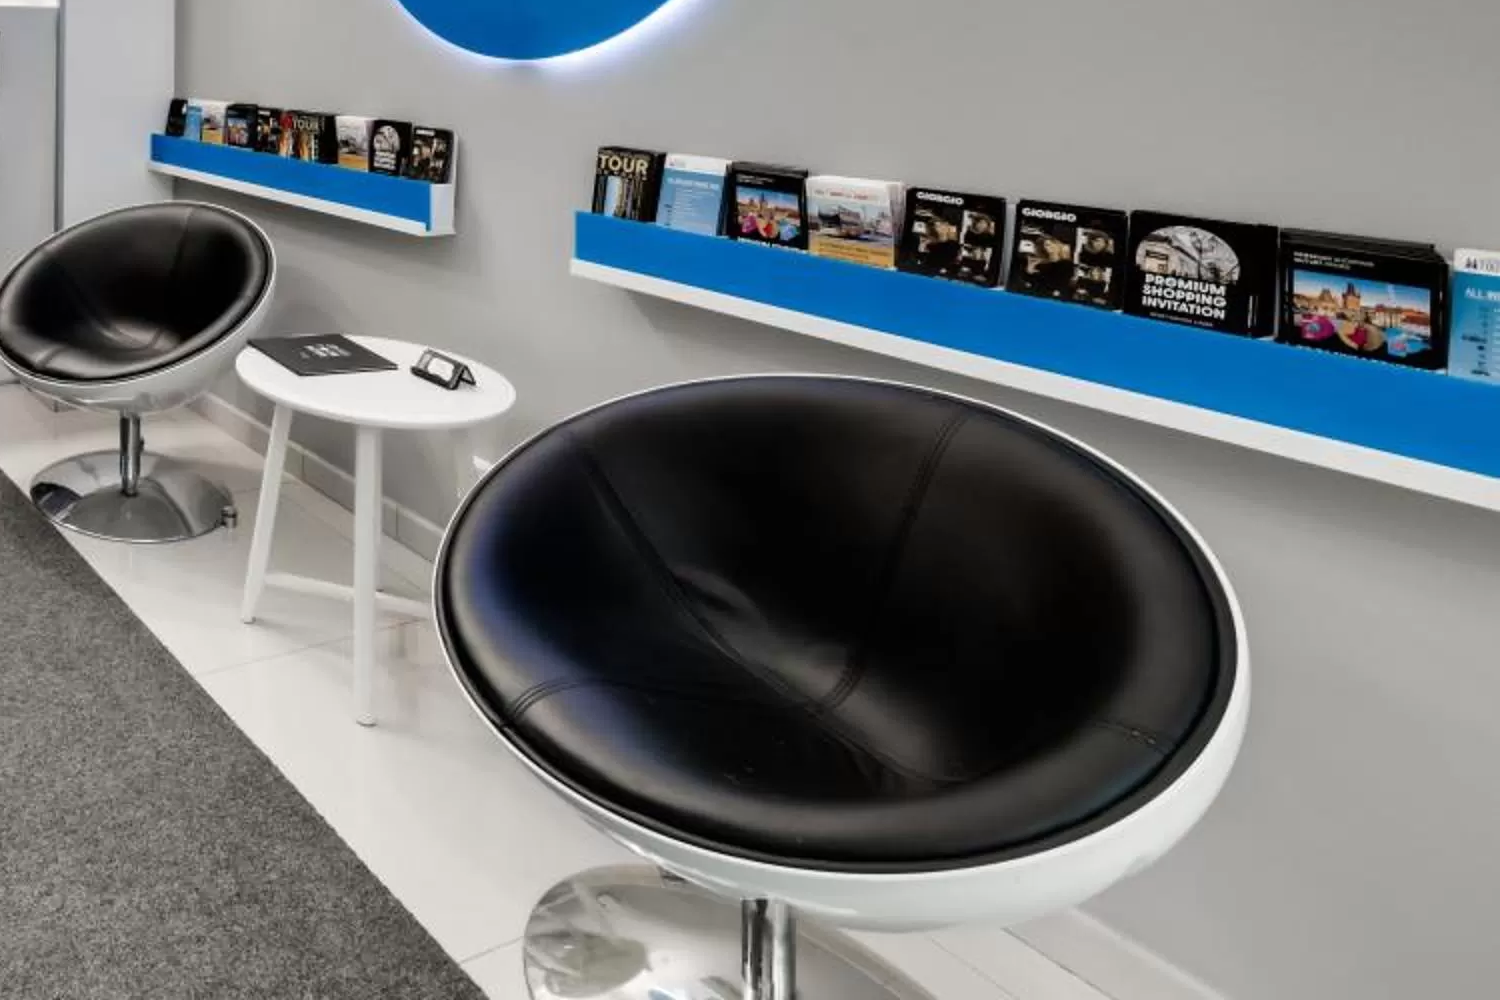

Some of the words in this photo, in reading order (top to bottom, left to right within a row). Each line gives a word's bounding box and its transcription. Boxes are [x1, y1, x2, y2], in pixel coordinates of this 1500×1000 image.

[599, 155, 648, 174] TOUR
[1141, 295, 1226, 320] INVITATION
[1143, 283, 1227, 308] SHOPPING
